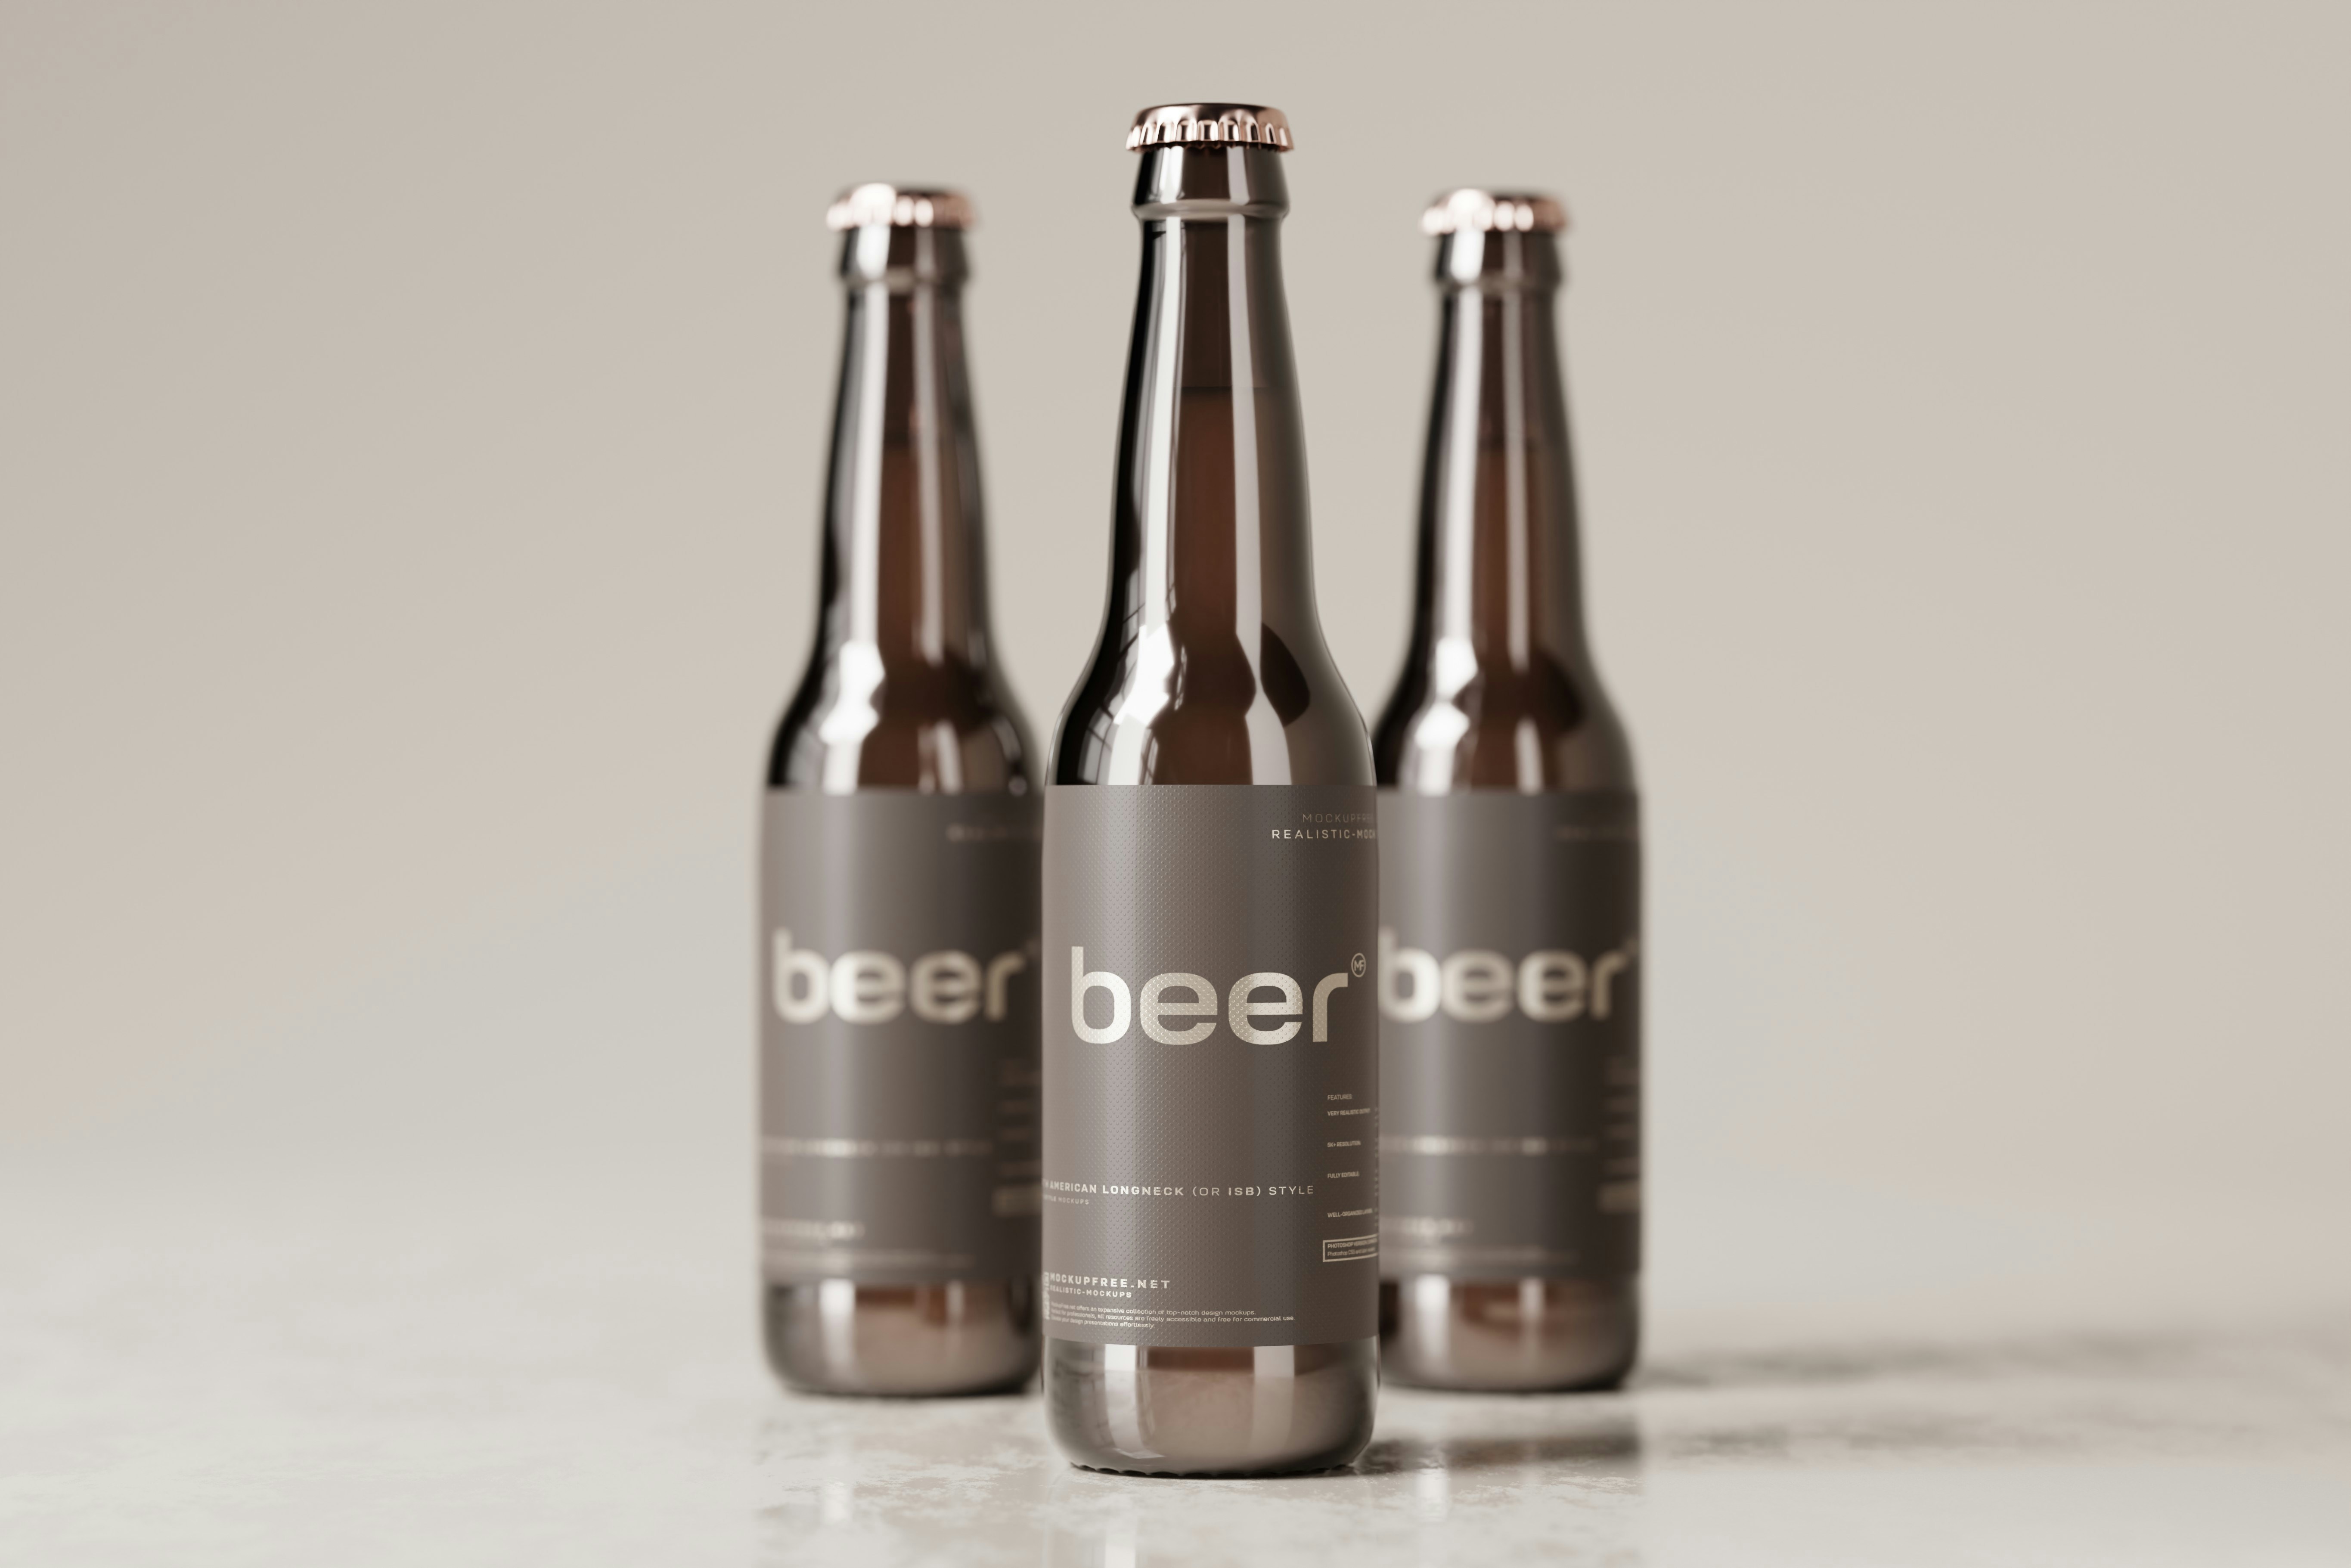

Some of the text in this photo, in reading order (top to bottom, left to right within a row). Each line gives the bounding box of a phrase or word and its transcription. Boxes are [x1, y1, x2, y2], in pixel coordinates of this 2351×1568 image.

[773, 929, 1026, 1023] beer
[1378, 928, 1628, 1023] beer
[1071, 946, 1348, 1045] beer
[1049, 1181, 1097, 1193] AMERICAN
[1102, 1185, 1184, 1196] LONGNECK
[1192, 1187, 1220, 1197] (OR
[1228, 1186, 1262, 1196] ISB)
[1269, 1185, 1314, 1196] STYLE
[1058, 1196, 1089, 1205] MOCKUPS
[1050, 1272, 1170, 1289] MOCKUPFREE.NET
[1120, 1321, 1155, 1329] effortlessly.
